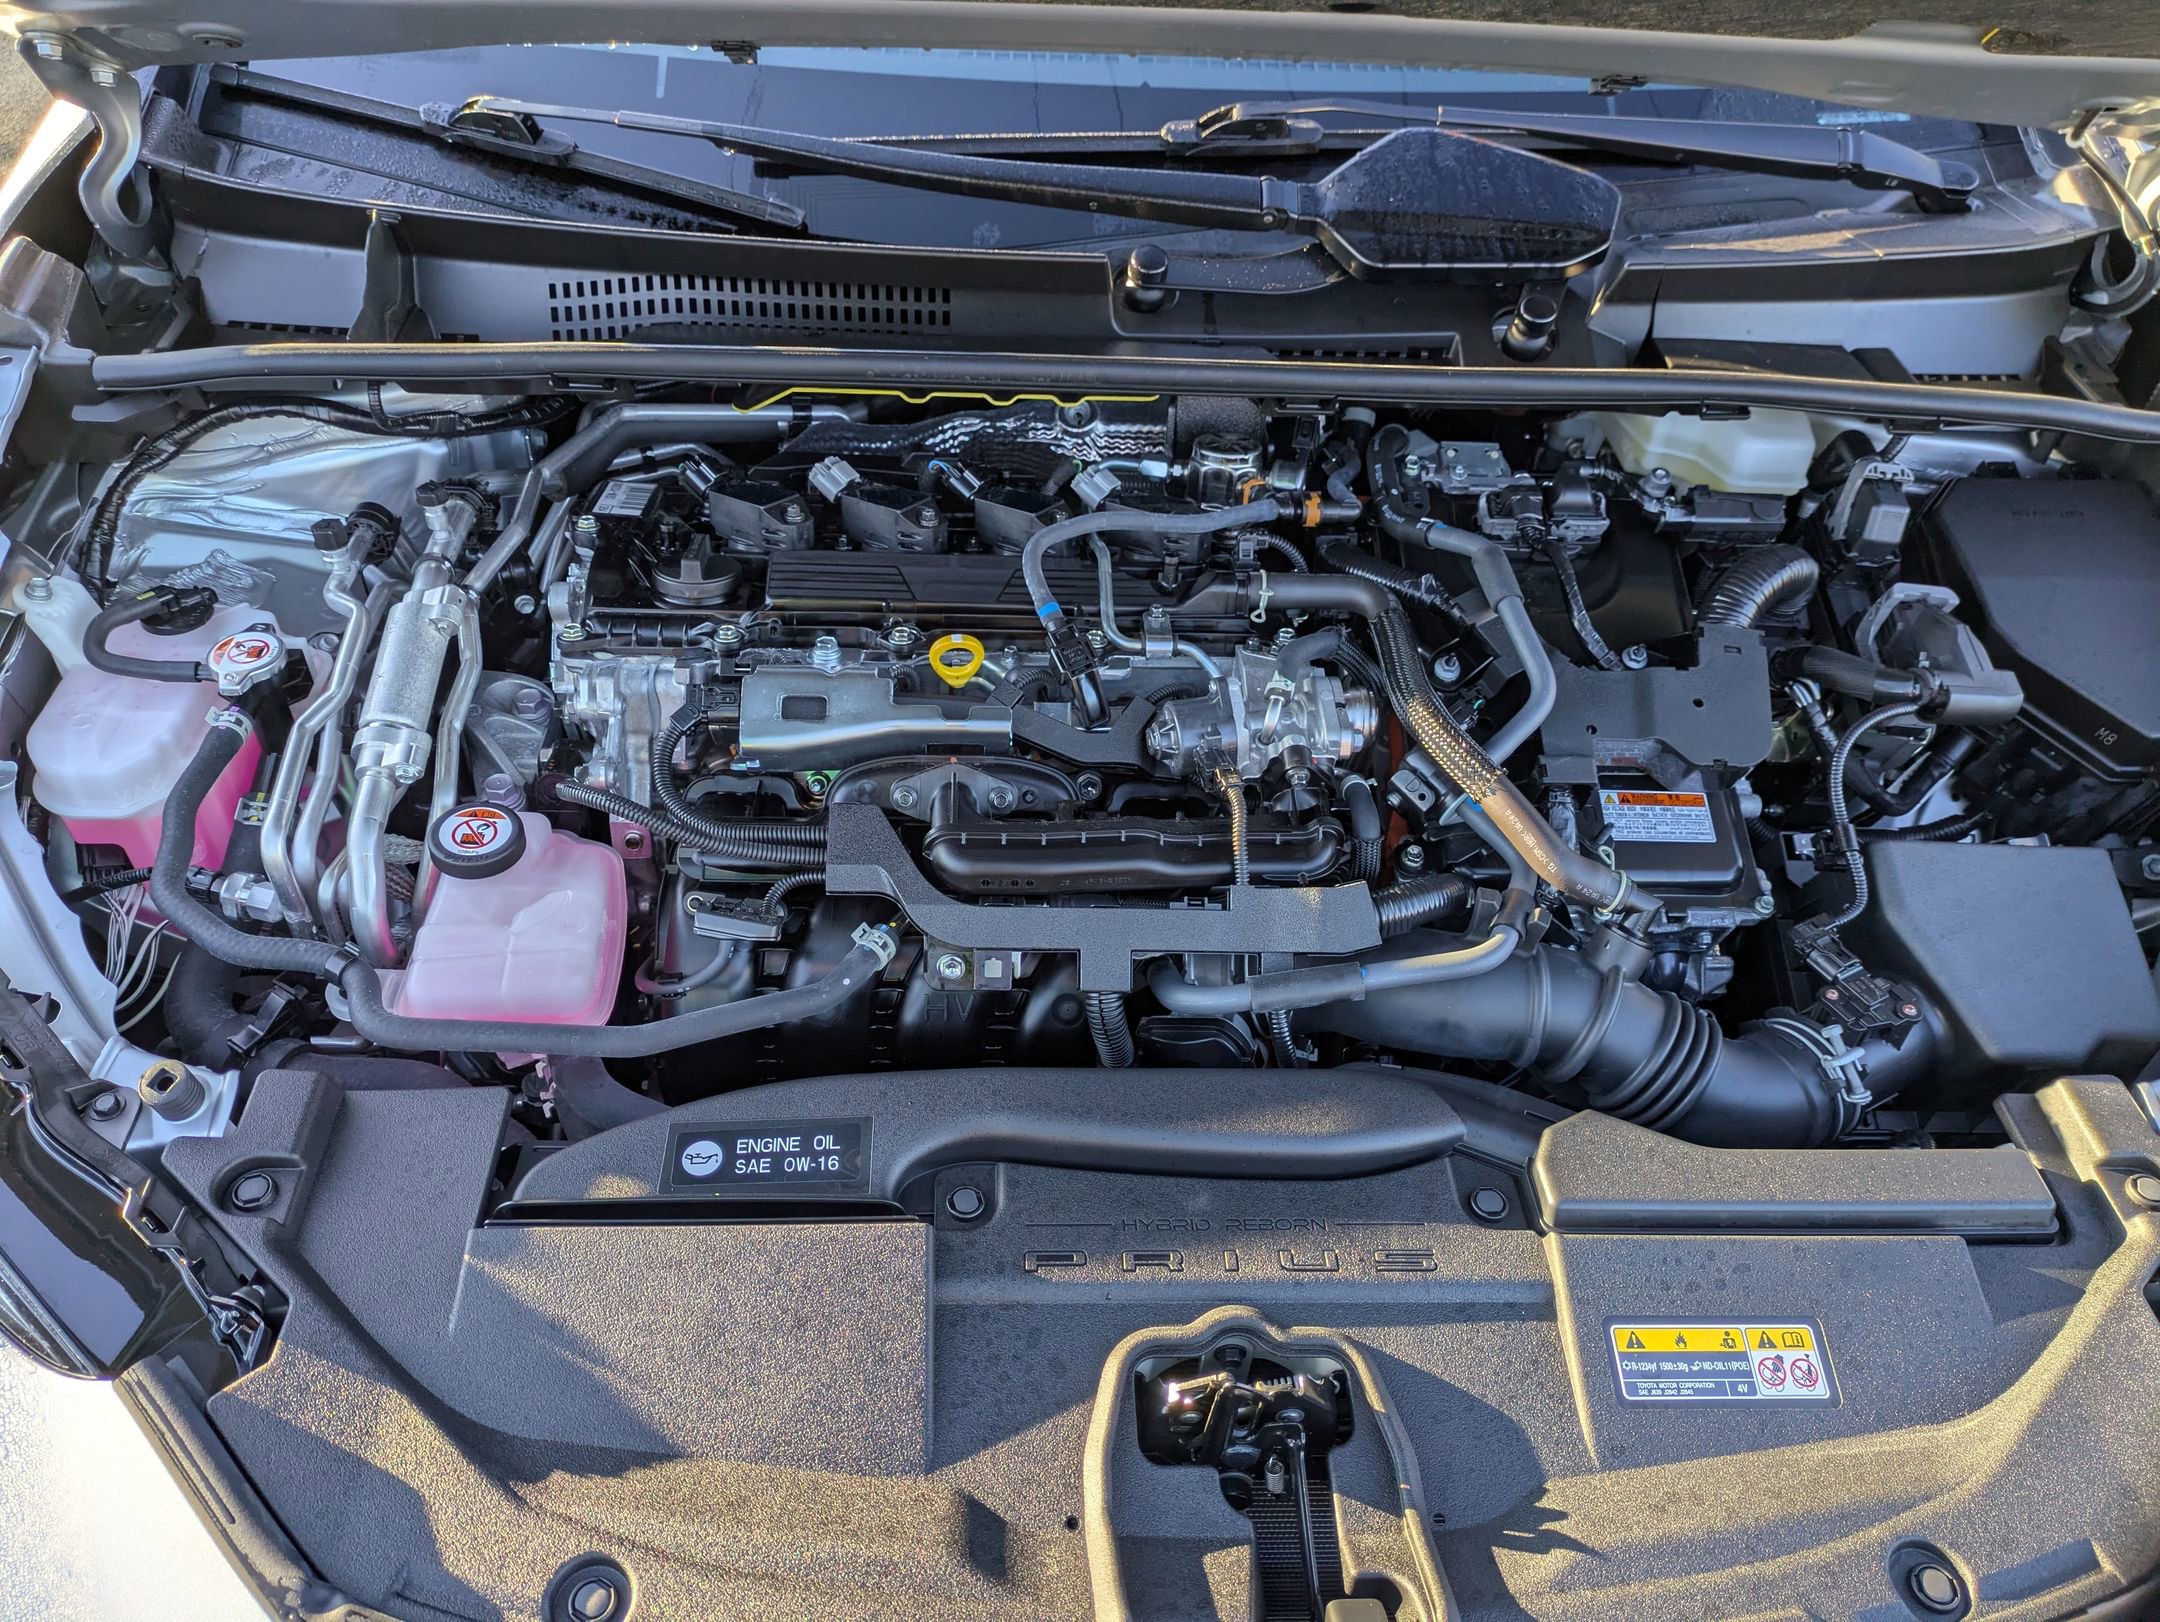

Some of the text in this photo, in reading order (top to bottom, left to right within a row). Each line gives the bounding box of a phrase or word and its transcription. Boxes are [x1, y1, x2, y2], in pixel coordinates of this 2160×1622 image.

[922, 993, 976, 1023] HV
[736, 1135, 840, 1154] ENGINE OIL
[735, 1156, 839, 1174] SAE 0W-16
[1122, 1218, 1328, 1232] HYBRID REBORN
[1023, 1249, 1438, 1273] PRIUS
[1737, 1383, 1748, 1394] 4V
